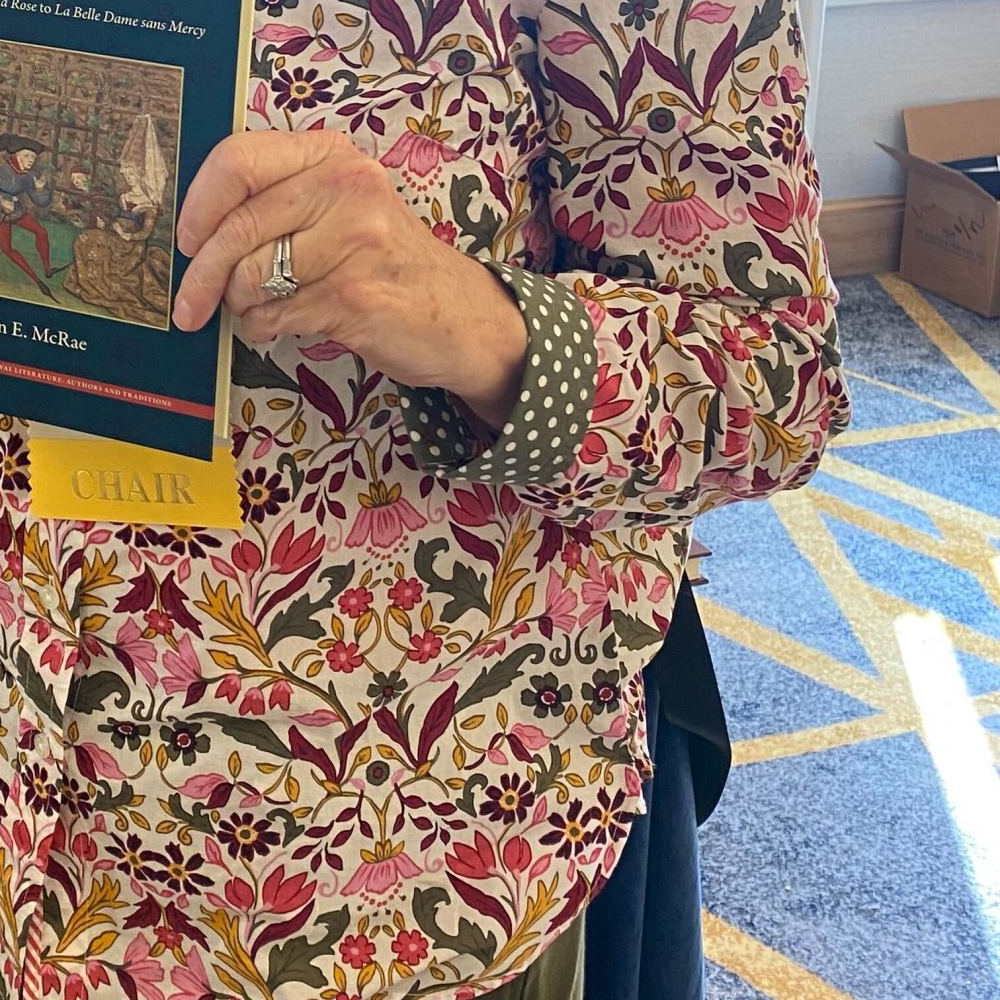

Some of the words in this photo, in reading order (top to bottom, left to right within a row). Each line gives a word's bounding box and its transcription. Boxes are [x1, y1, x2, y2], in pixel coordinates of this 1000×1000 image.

[39, 2, 52, 14] to
[54, 3, 70, 17] La
[72, 6, 101, 21] Belle
[103, 10, 139, 27] Dame
[140, 18, 166, 31] sans
[168, 20, 206, 40] Mercy
[11, 321, 28, 338] E.
[32, 325, 88, 351] McRae
[66, 378, 102, 391] AUTHORS
[104, 387, 121, 396] AND
[122, 391, 172, 407] TRADITIONS
[71, 468, 195, 505] CHAIR
